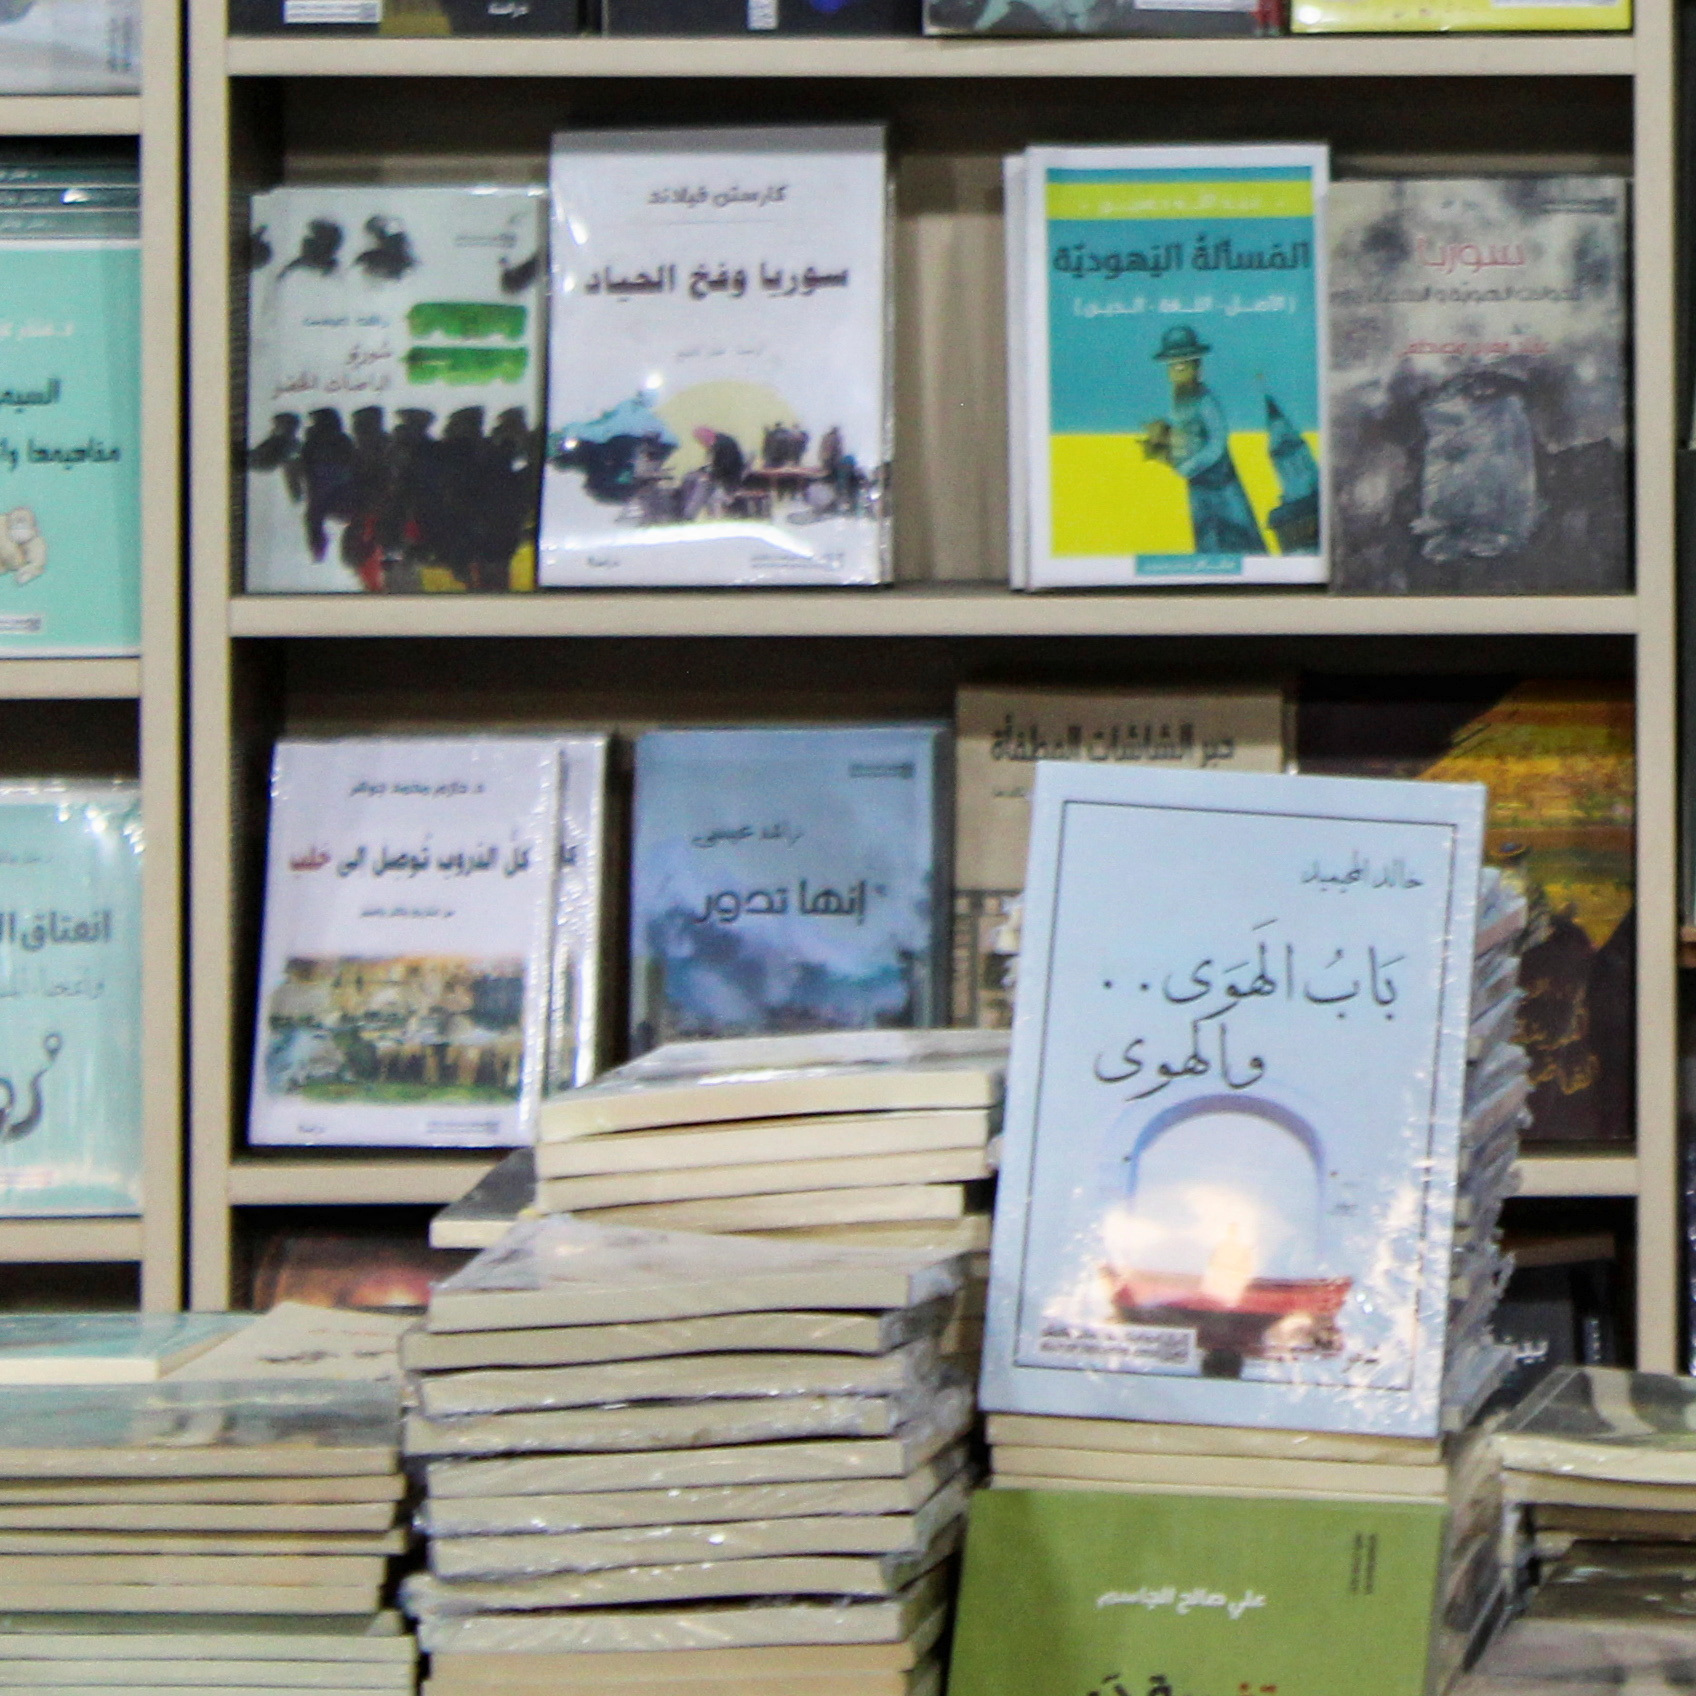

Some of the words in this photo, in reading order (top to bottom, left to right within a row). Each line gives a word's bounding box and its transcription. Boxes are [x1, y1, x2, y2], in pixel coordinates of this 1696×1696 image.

[585, 265, 675, 303] الحياد
[688, 261, 747, 299] وفخ
[760, 261, 849, 297] سوريا
[692, 889, 789, 923] تدور
[800, 878, 867, 927] إنها
